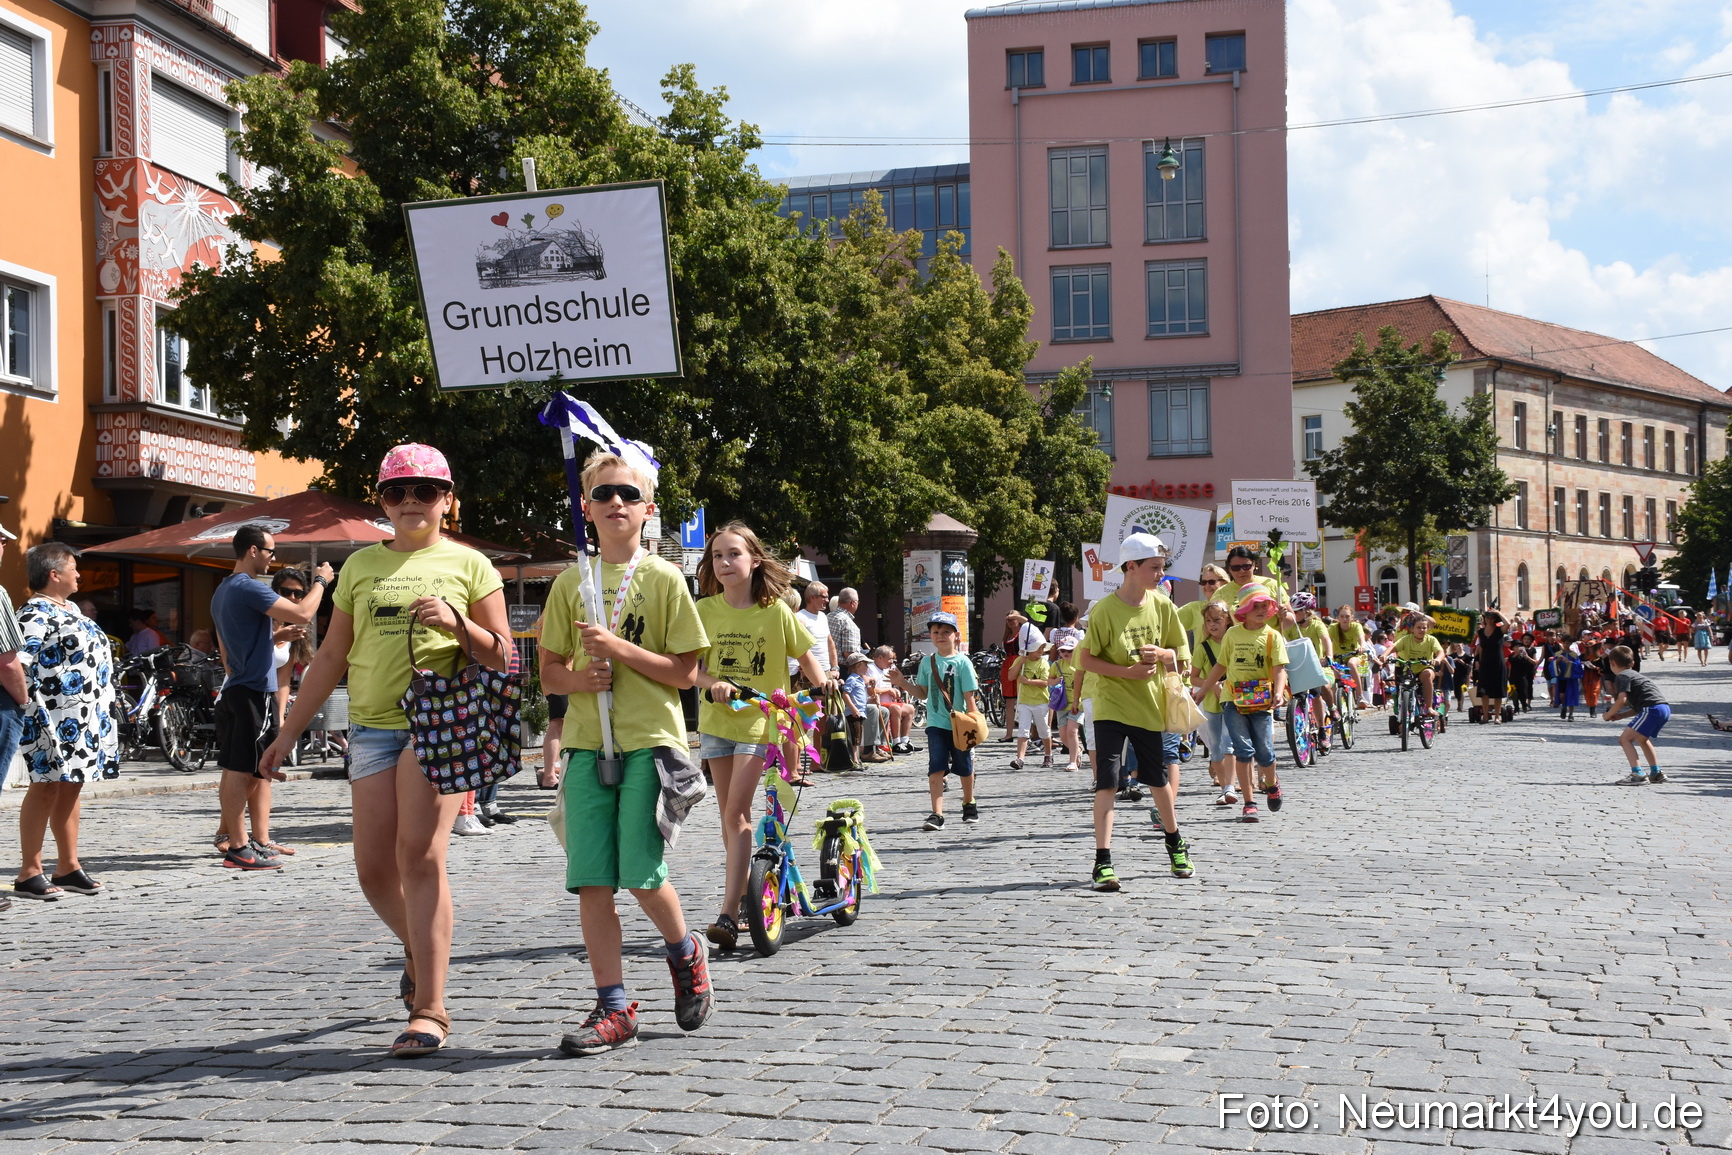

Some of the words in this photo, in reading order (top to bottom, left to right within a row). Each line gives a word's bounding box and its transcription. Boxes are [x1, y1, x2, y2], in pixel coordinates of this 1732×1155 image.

[442, 287, 650, 331] Grundschule
[480, 337, 632, 375] Holzheim
[1236, 497, 1290, 506] BesTec-Preis
[1291, 498, 1311, 507] 2016
[1121, 504, 1168, 527] UMWELTSCHULE
[1173, 514, 1188, 538] EUROPA
[1260, 515, 1267, 523] 1.
[1269, 515, 1290, 523] Preis
[686, 511, 699, 543] P
[373, 576, 423, 584] Grundschule
[1439, 613, 1463, 623] Schule
[379, 627, 428, 636] Umweltshule
[1433, 623, 1466, 634] Wolfstein
